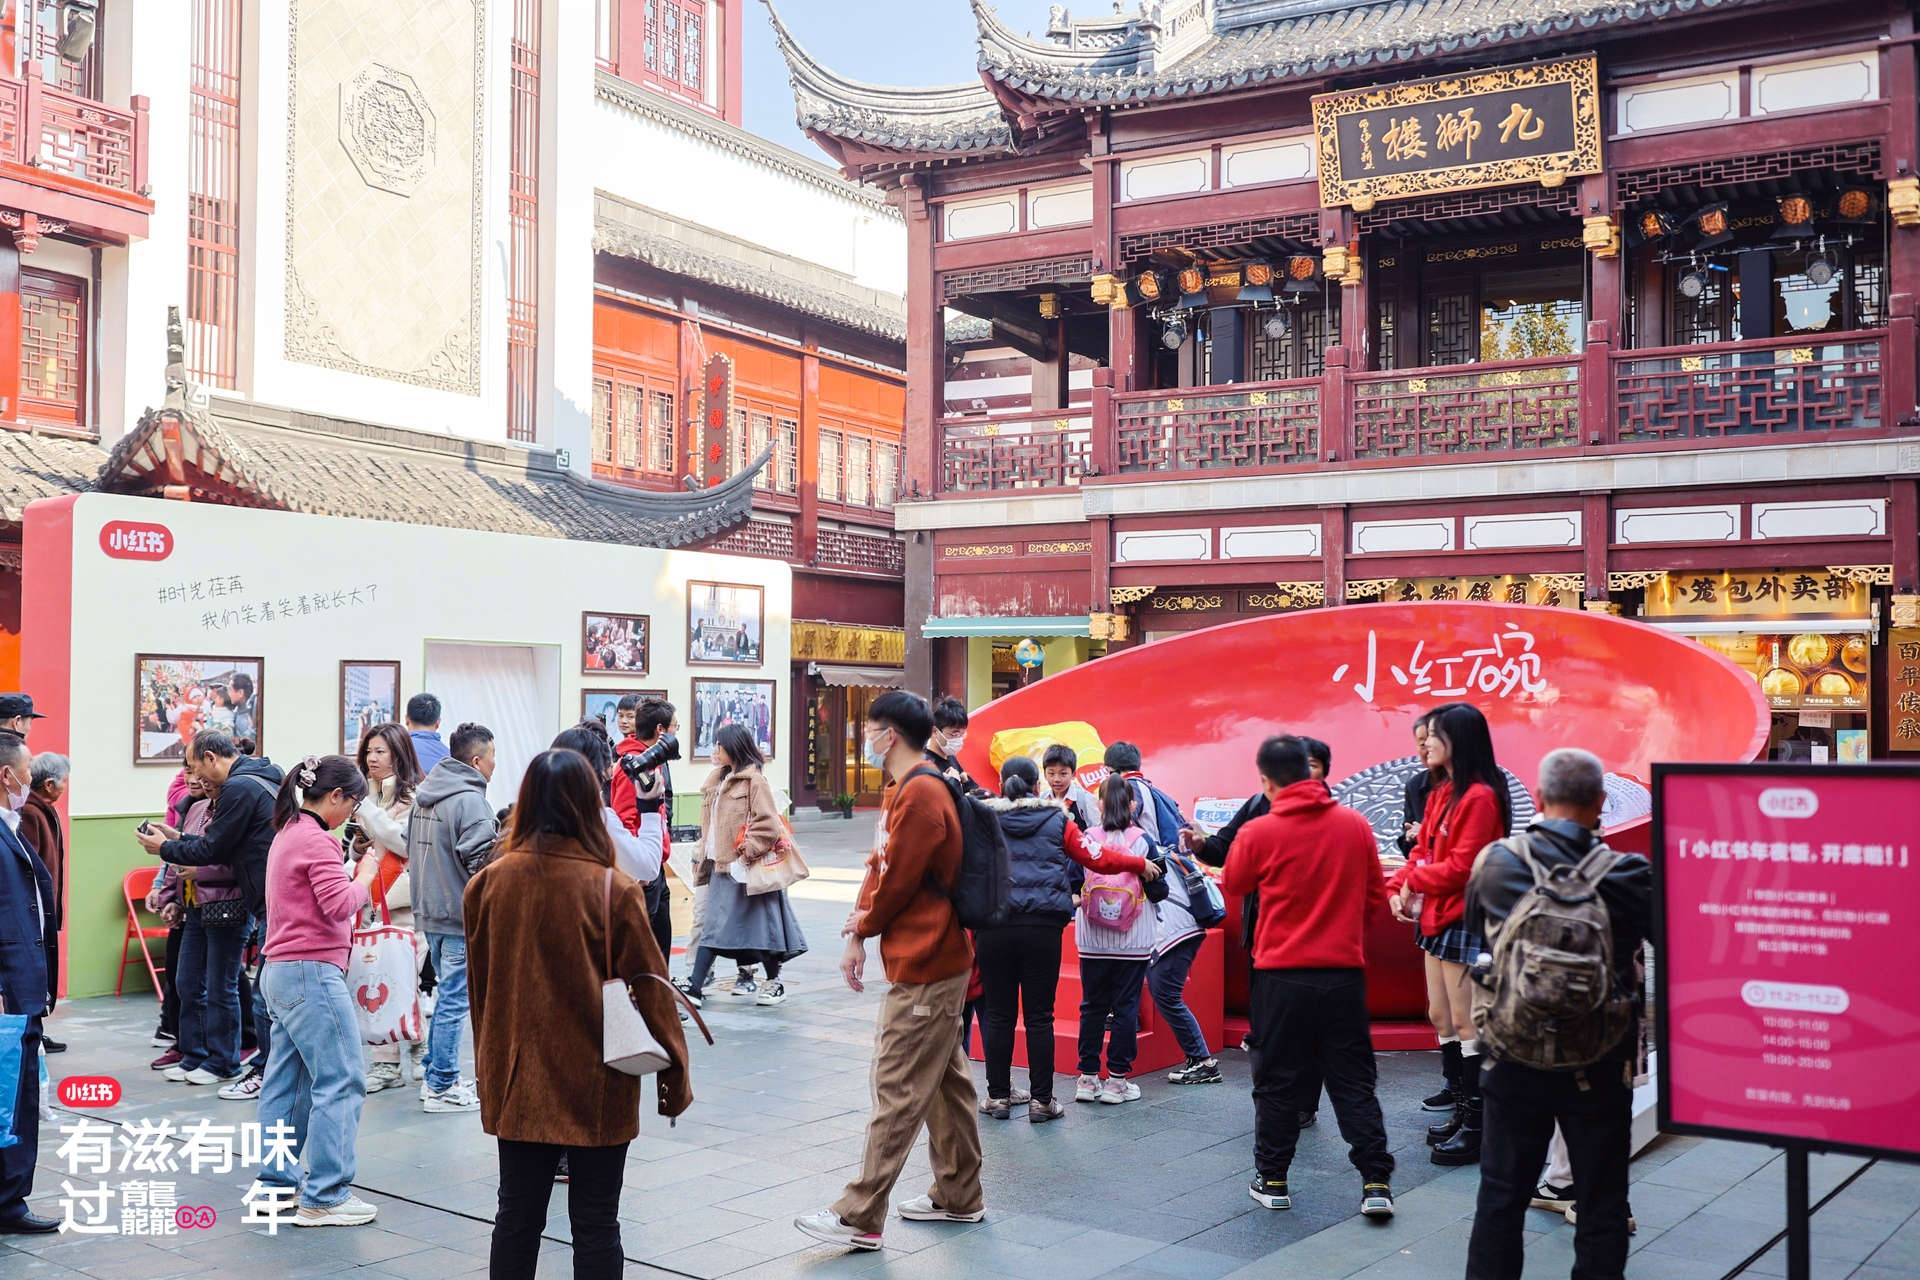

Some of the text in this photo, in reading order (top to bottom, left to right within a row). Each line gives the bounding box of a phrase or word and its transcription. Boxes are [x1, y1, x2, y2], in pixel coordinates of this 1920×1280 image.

[109, 528, 166, 554] 小红书
[201, 584, 378, 631] 我们笑着笑着就长大了
[1332, 622, 1548, 703] 小红碗
